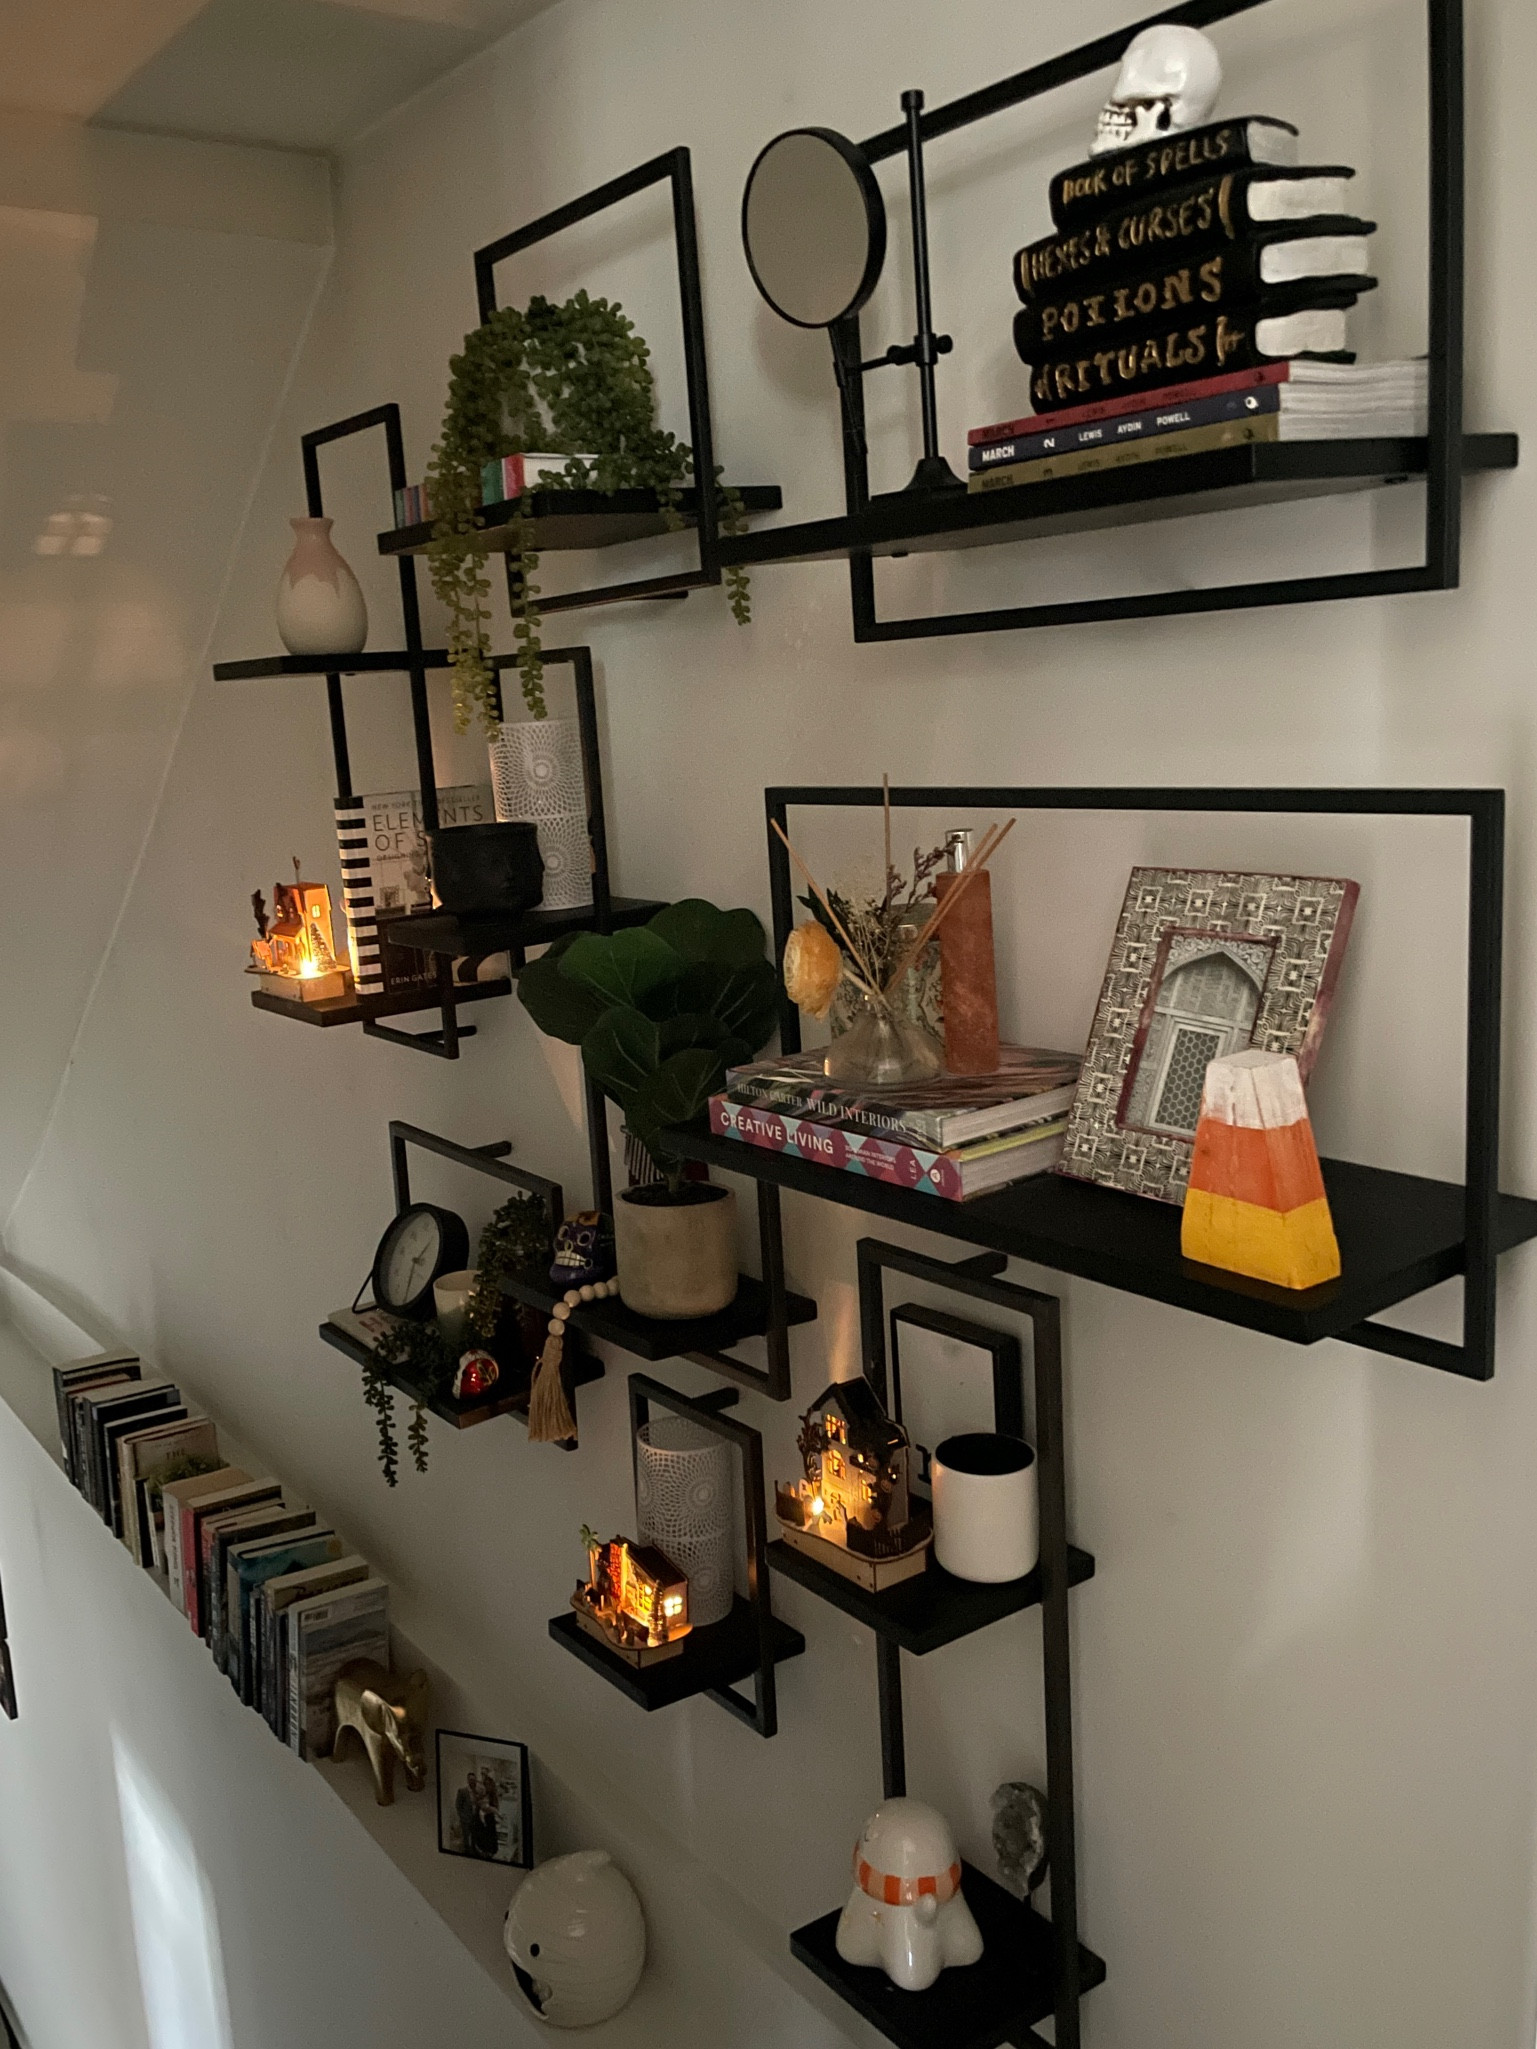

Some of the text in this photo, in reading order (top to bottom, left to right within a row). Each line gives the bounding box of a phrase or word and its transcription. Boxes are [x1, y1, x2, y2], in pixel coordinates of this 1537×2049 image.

[1062, 130, 1231, 204] BOOK OF SPELLS
[1030, 228, 1091, 282] HEXES
[1117, 186, 1215, 249] CURSES
[1041, 256, 1223, 342] POTIONS
[1055, 326, 1207, 400] RITUALS
[981, 444, 1016, 462] MARCH
[1078, 428, 1104, 442] LEWIS
[1117, 420, 1143, 434] AYDIN
[1156, 410, 1191, 427] POWELL
[981, 473, 1015, 489] MARCH
[373, 805, 484, 832] ELEMNTS
[375, 832, 406, 852] OF
[390, 975, 410, 985] ERIN
[737, 1083, 768, 1099] HILTON
[769, 1090, 803, 1107] CARTER
[806, 1098, 838, 1117] WILD
[840, 1104, 907, 1133] INTERIORS
[720, 1111, 834, 1155] CREATIVE LIVING
[909, 1160, 918, 1180] LEA
